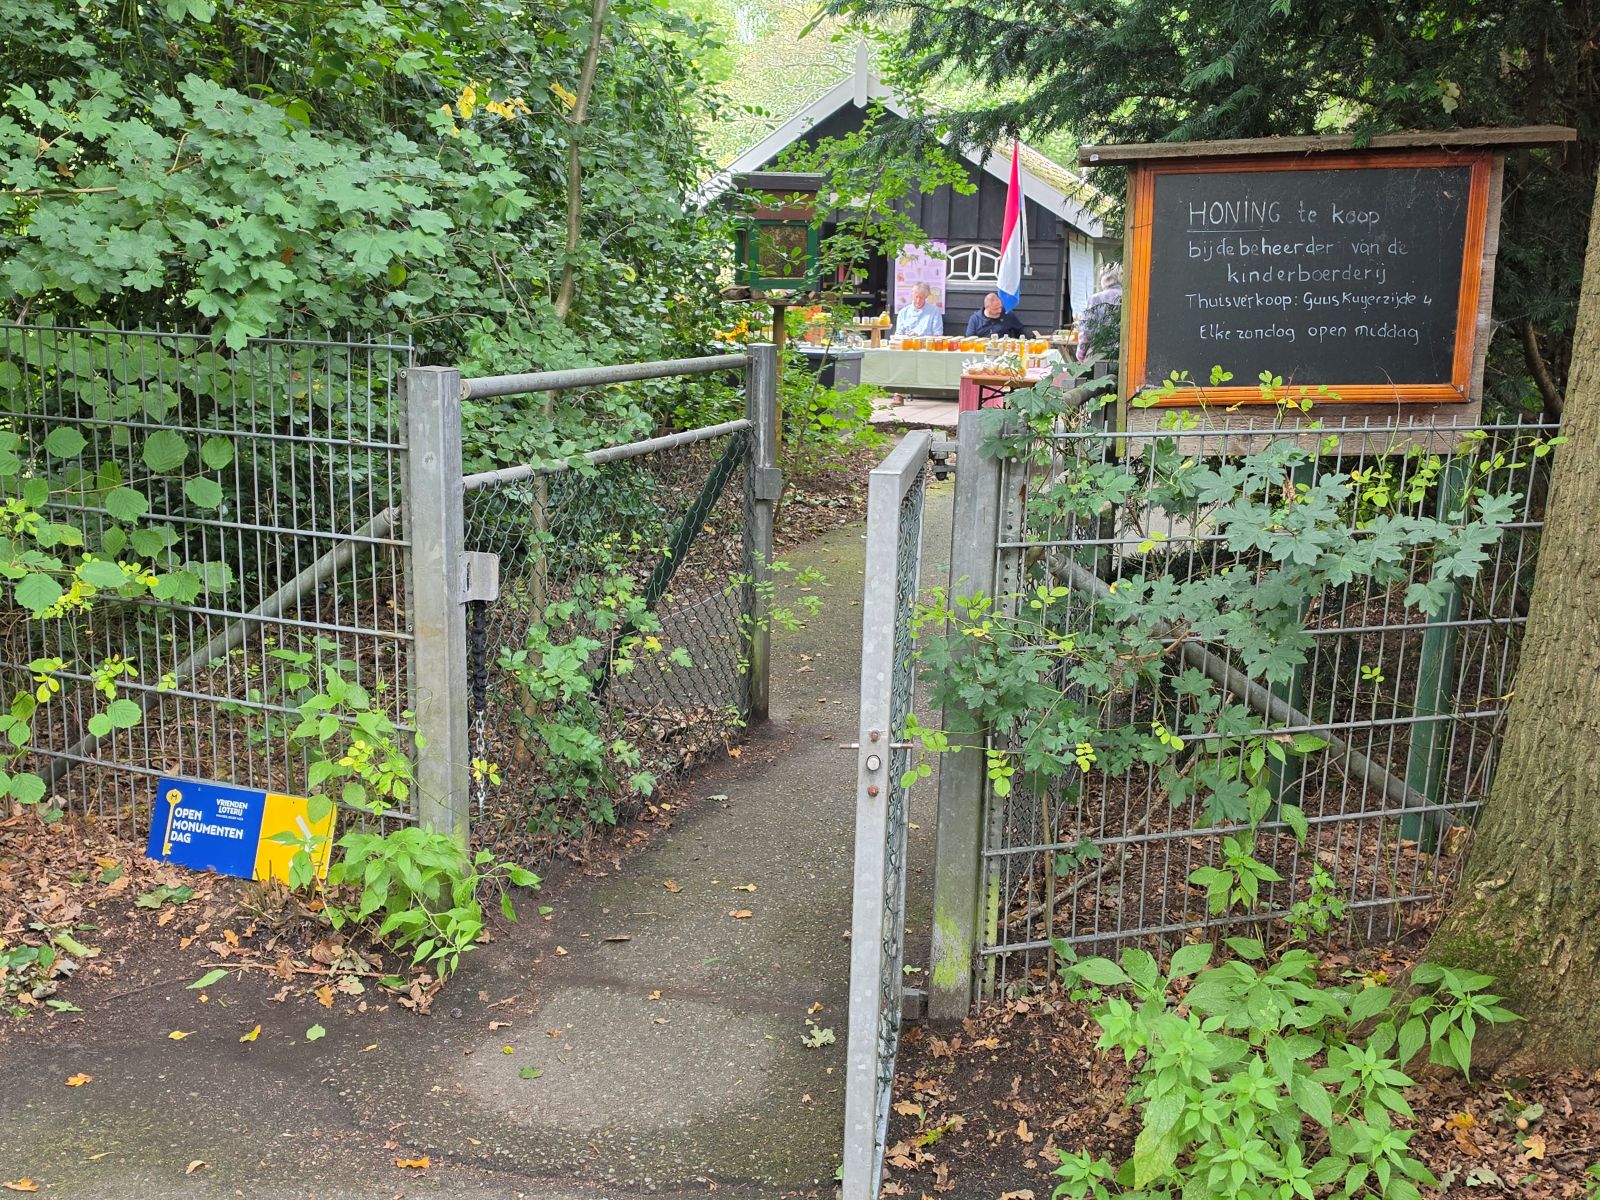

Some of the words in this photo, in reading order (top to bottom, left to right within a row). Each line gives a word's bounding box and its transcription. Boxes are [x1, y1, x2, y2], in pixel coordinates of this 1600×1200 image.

[1188, 196, 1280, 226] HONING
[1298, 200, 1317, 223] te
[1331, 202, 1380, 233] koop
[1239, 236, 1334, 257] beheerder
[1351, 239, 1380, 256] van
[1387, 237, 1409, 255] de
[1227, 262, 1387, 284] kinderboerderij
[1185, 292, 1298, 311] Thuisverkoop:
[1303, 291, 1340, 311] Guus
[1423, 296, 1433, 306] 4
[1199, 322, 1231, 340] Elke
[1307, 325, 1347, 343] open
[1355, 322, 1419, 346] middag
[175, 808, 202, 820] OPEN
[216, 799, 248, 809] VRIENDEN
[219, 806, 243, 816] LOTERIJ
[171, 831, 191, 843] DAG
[173, 819, 243, 839] MONUMENTEN
